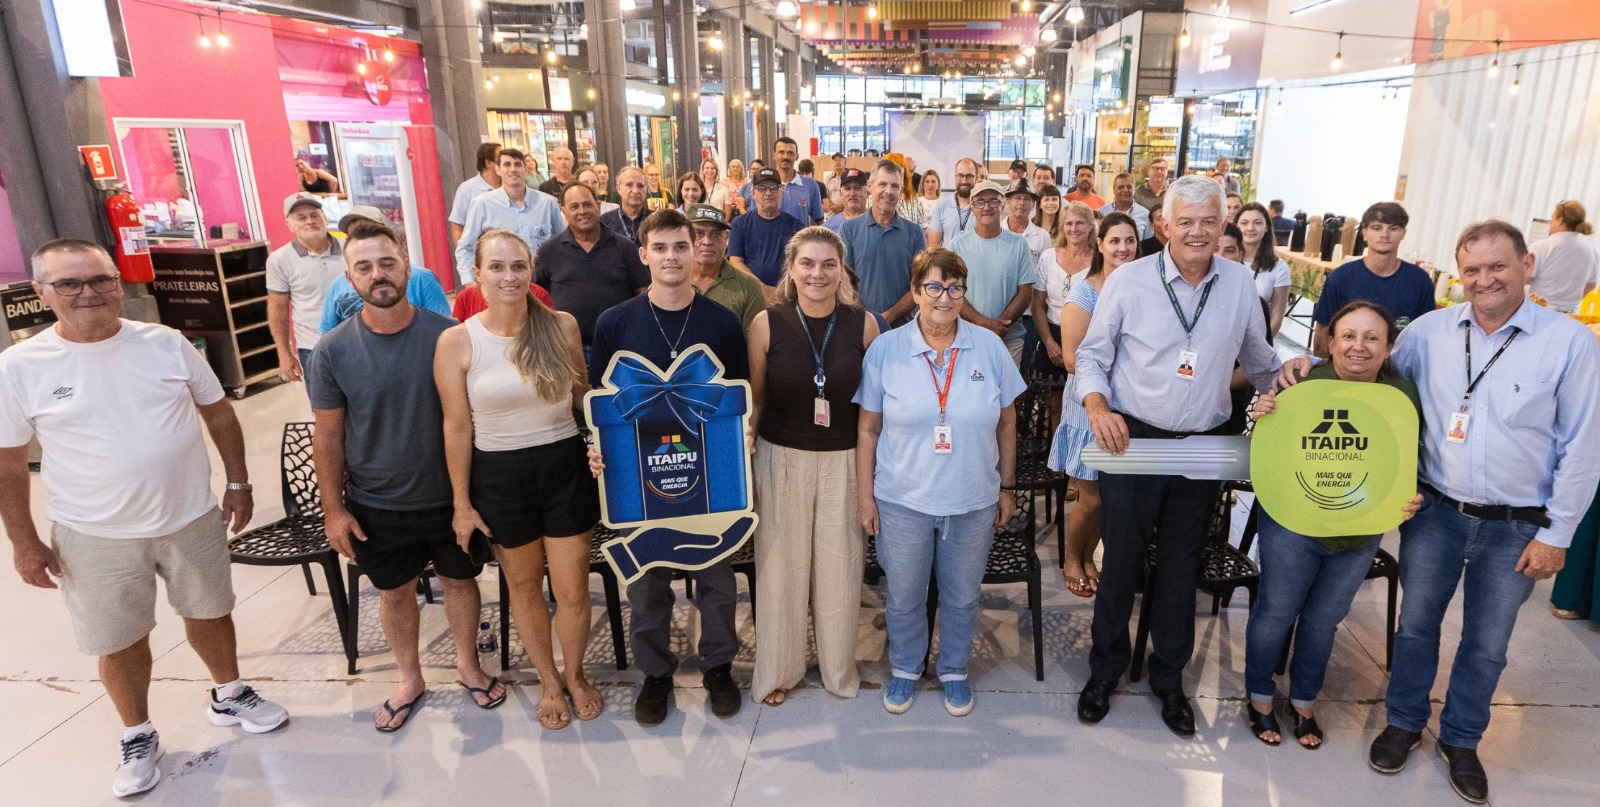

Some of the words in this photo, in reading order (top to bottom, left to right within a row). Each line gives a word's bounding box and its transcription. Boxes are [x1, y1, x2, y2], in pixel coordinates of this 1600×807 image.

[153, 281, 220, 292] PRATELEIRAS
[1302, 436, 1368, 450] ITAIPU
[647, 452, 697, 466] ITAIPU
[1305, 452, 1364, 461] BINACIONAL
[651, 463, 696, 472] BINACIONAL
